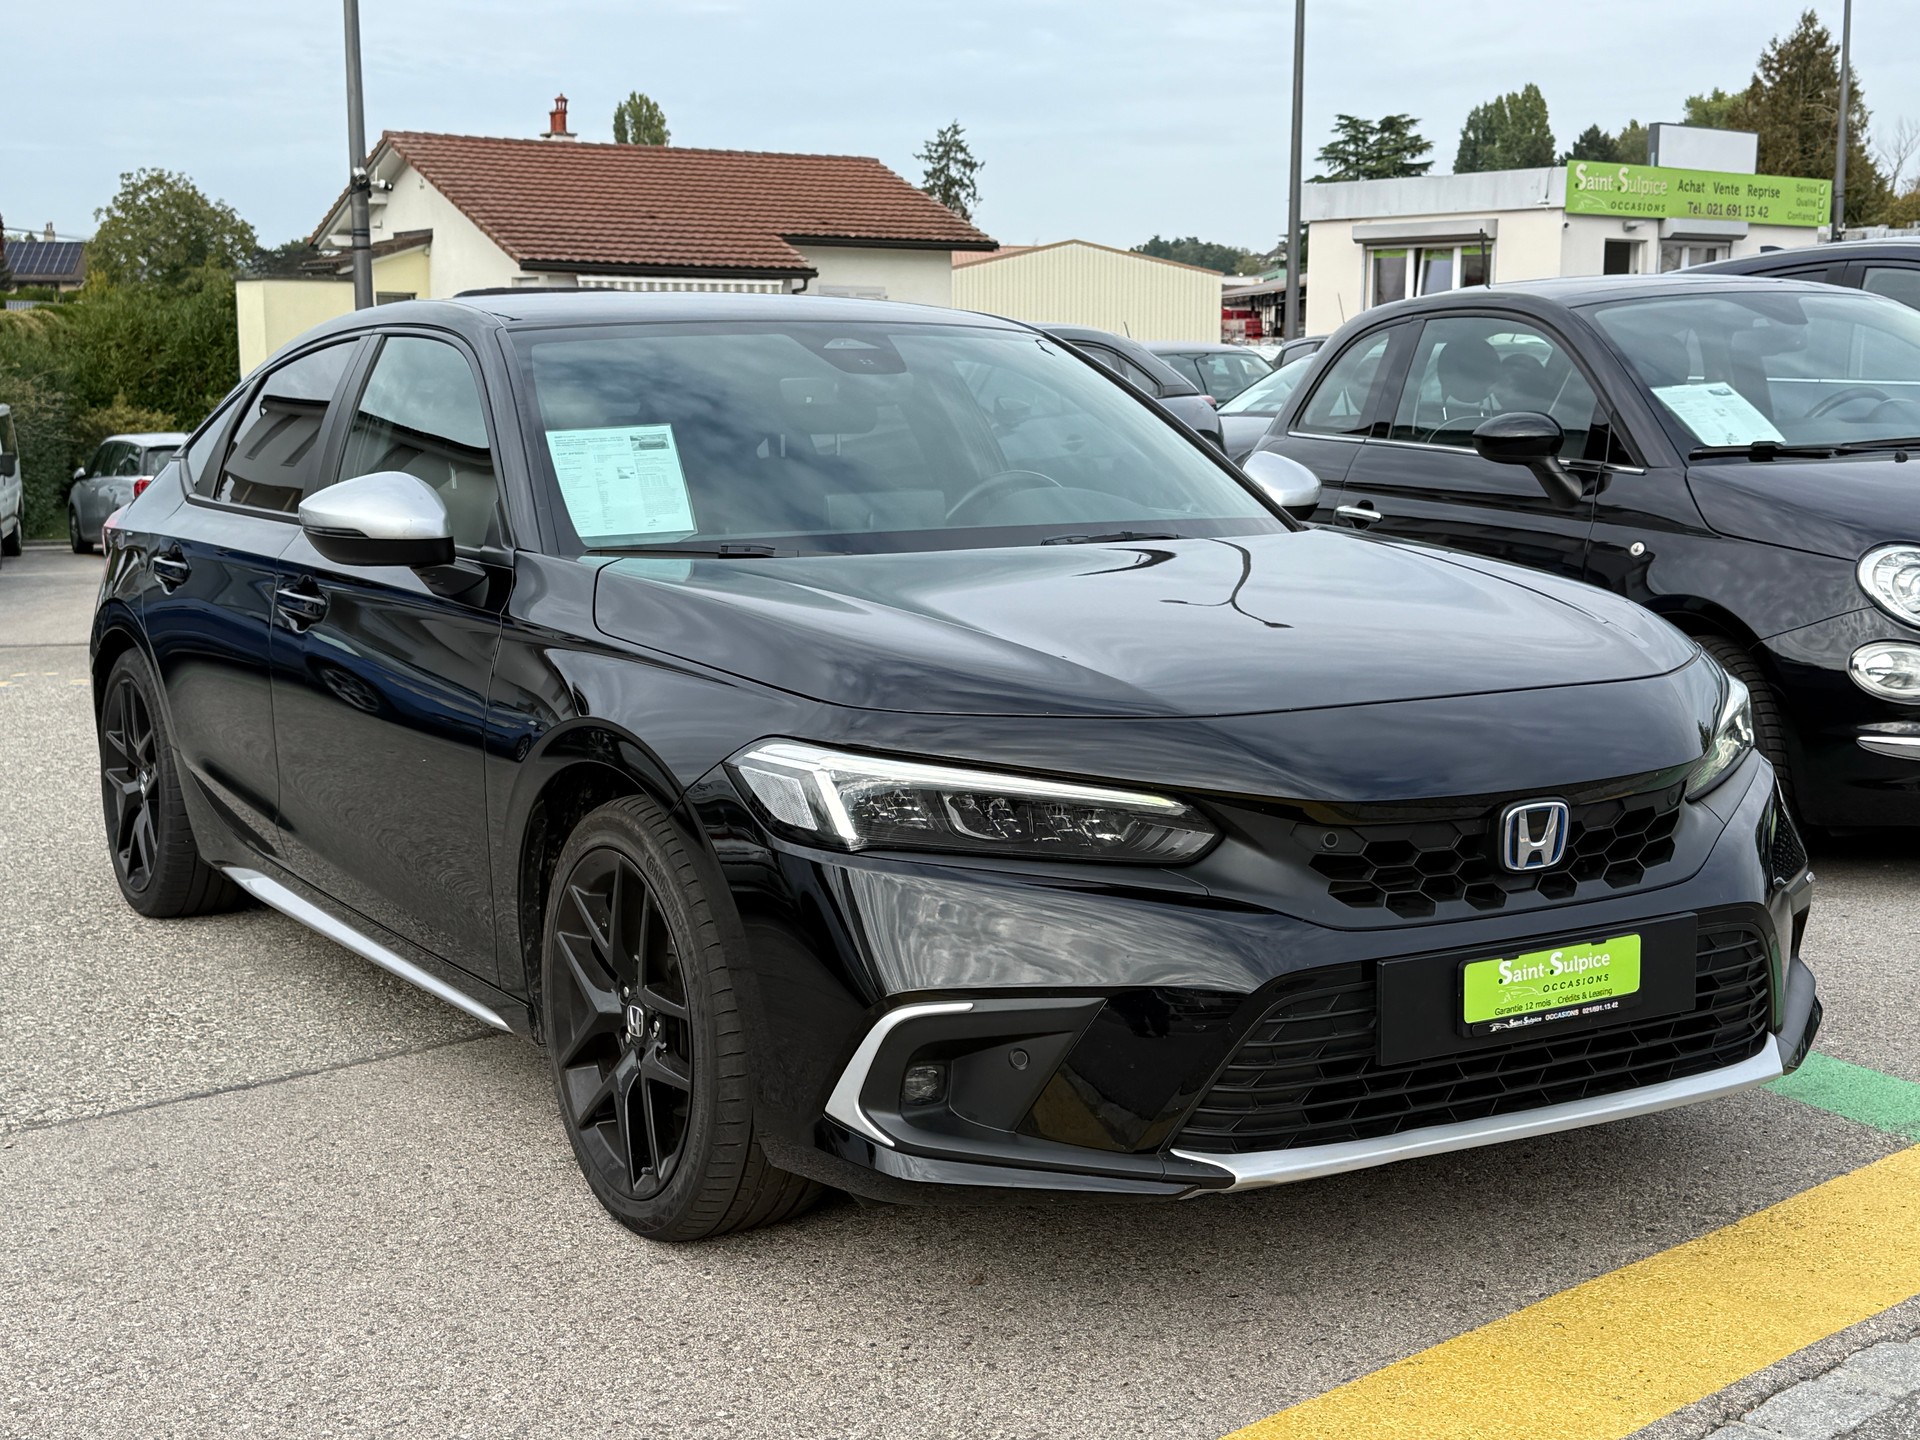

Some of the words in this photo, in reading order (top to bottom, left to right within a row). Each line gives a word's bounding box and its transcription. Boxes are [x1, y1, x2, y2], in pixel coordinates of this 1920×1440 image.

[1575, 163, 1668, 197] Saint-Sulpice
[1677, 179, 1705, 193] Achat
[1713, 182, 1740, 196] Vente
[1747, 184, 1781, 200] Reprise
[1610, 201, 1666, 213] OCCASIONS
[1706, 202, 1723, 216] 021
[1726, 203, 1742, 217] 691
[1745, 205, 1755, 218] 13
[1757, 206, 1769, 218] 42
[1498, 951, 1611, 985] Saint-Sulpice
[1542, 973, 1610, 993] OCCASIONS
[1494, 1003, 1523, 1016] Garantie
[1525, 1002, 1534, 1010] 12
[1535, 999, 1552, 1009] mois
[1557, 994, 1581, 1005] Crédits
[1582, 992, 1588, 1000] &
[1588, 988, 1613, 999] Leasing
[1545, 1009, 1580, 1021] OCCASIONS
